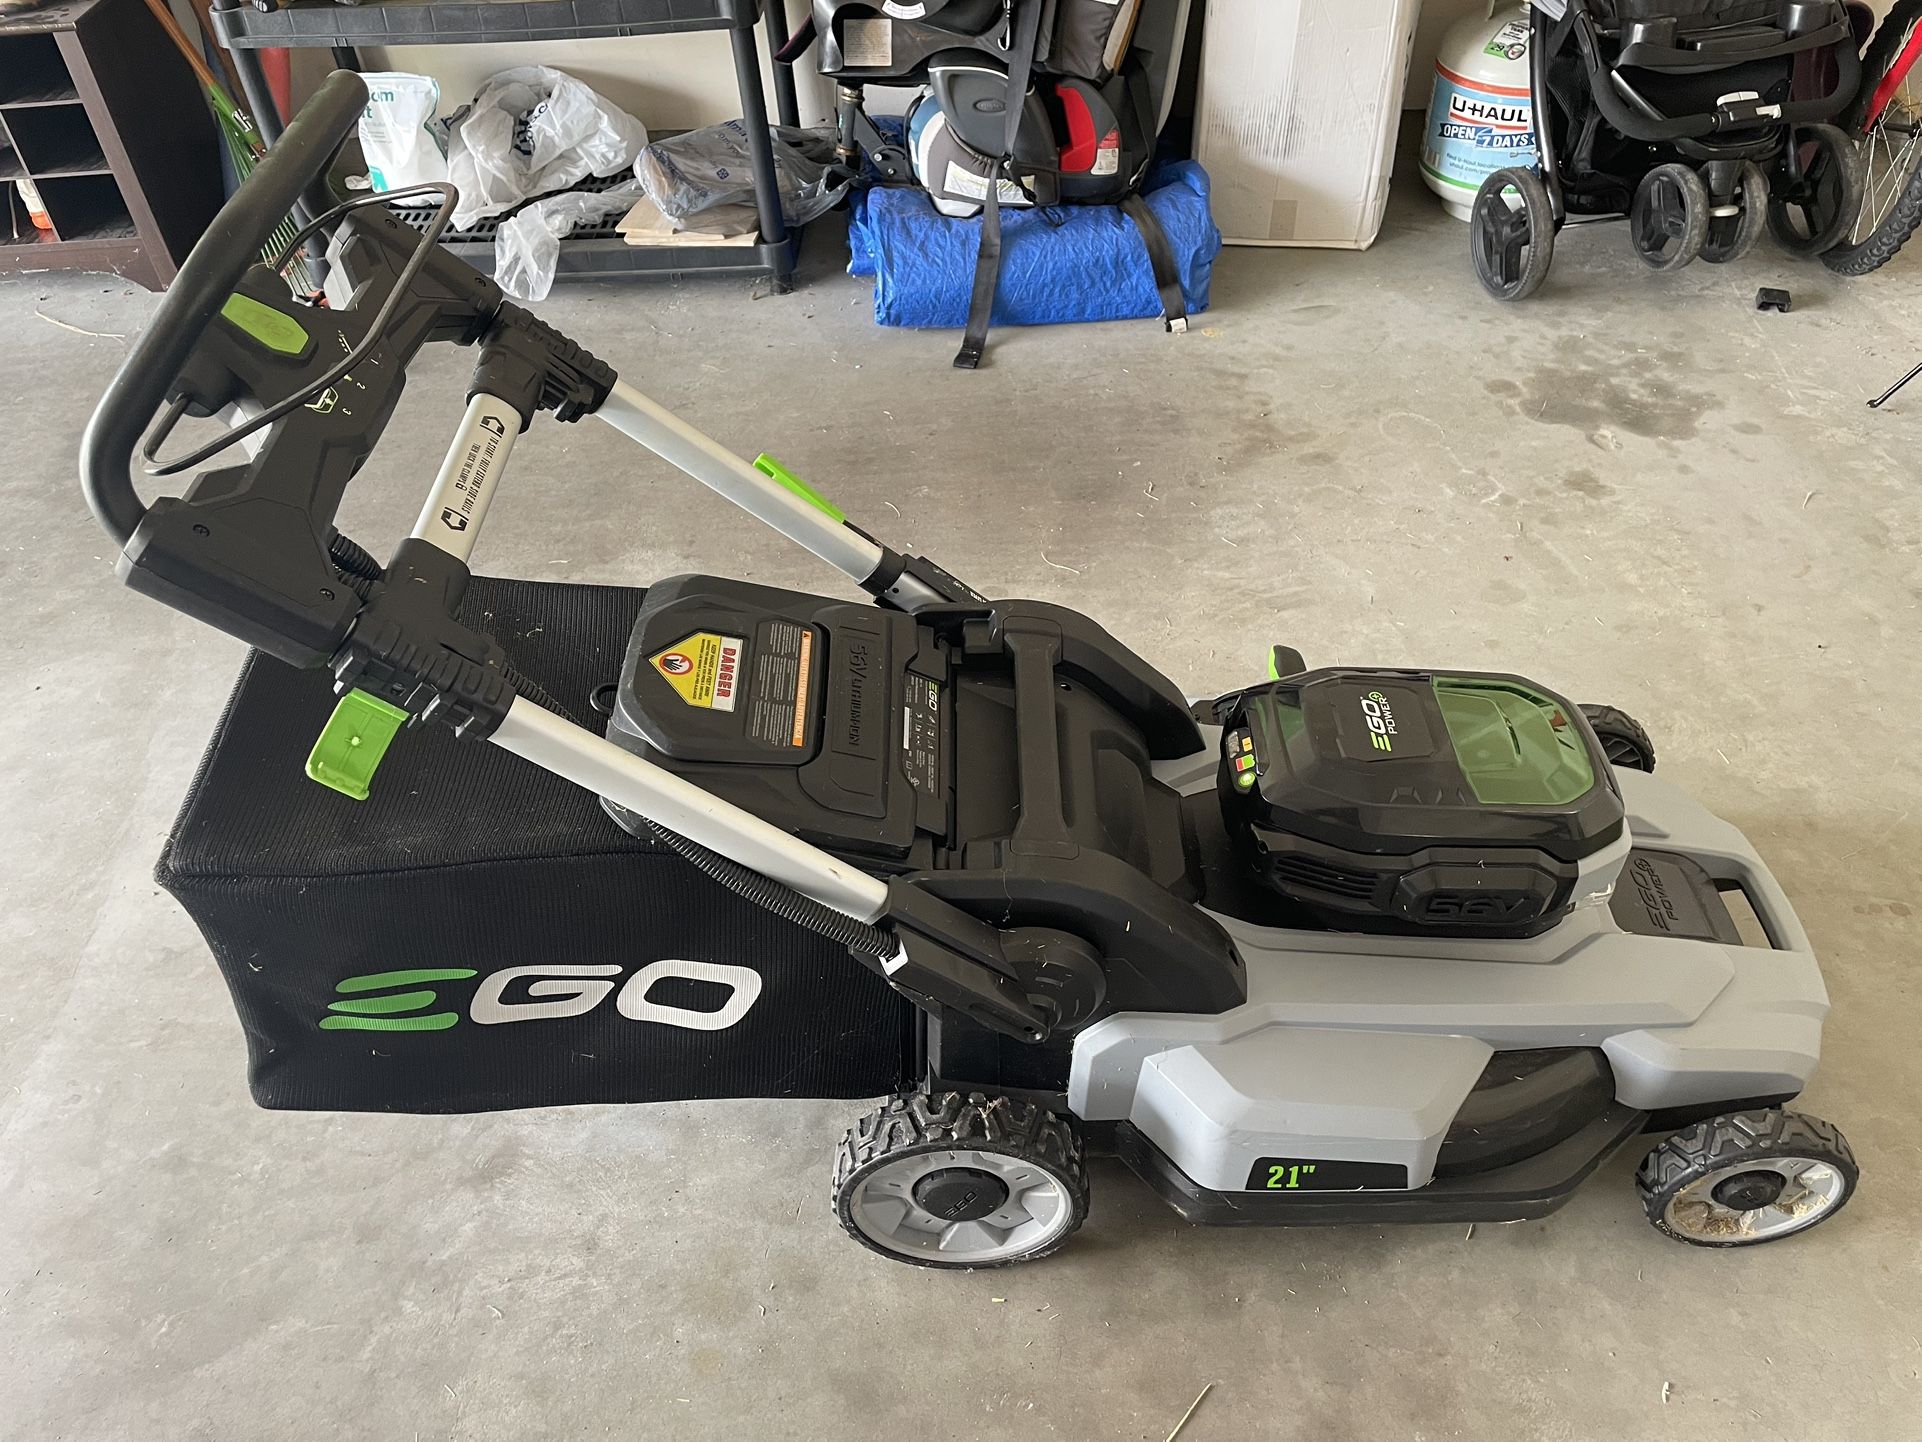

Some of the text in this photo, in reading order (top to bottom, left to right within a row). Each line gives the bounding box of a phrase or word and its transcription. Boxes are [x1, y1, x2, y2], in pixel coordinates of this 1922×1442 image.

[371, 91, 394, 102] om
[1452, 96, 1528, 123] U-HAUL
[1443, 124, 1529, 147] OPEN 7 DAYS
[716, 646, 736, 697] DANGER
[928, 681, 937, 710] EGO
[1361, 699, 1391, 752] EGO
[1629, 869, 1670, 931] EGO
[319, 959, 763, 1031] EGO
[1266, 1165, 1316, 1188] 21"
[944, 1191, 978, 1217] EGO
